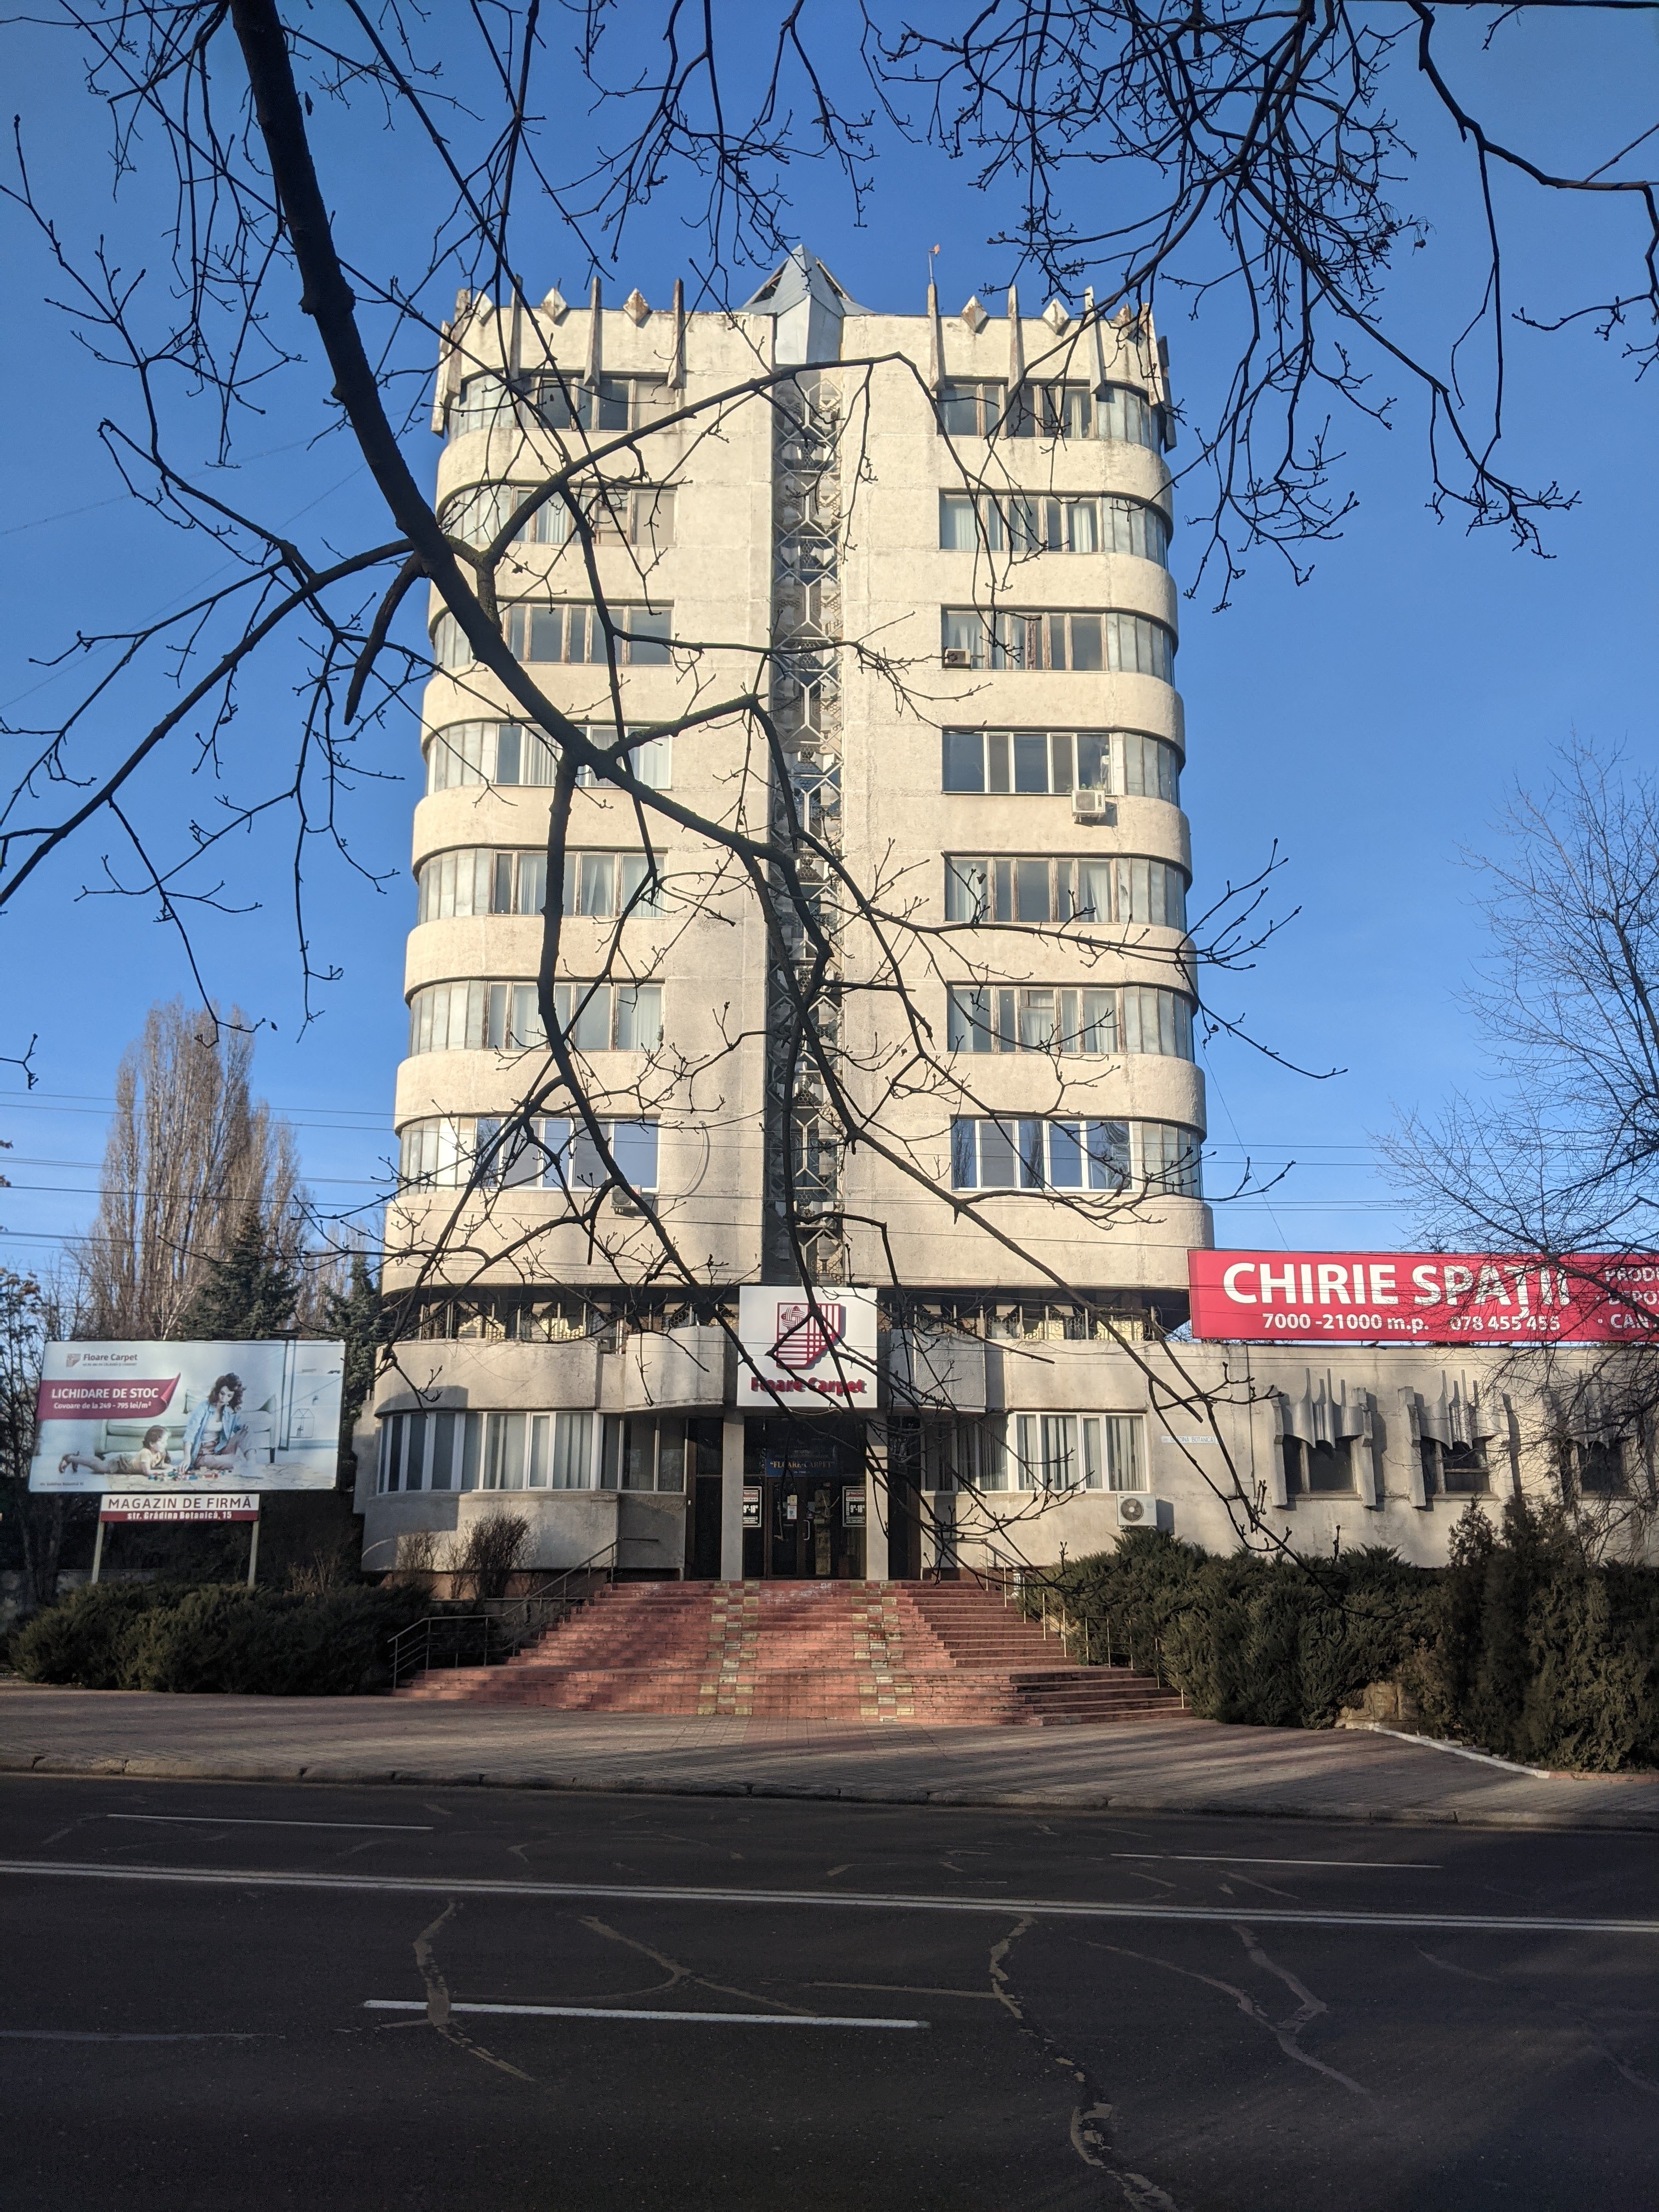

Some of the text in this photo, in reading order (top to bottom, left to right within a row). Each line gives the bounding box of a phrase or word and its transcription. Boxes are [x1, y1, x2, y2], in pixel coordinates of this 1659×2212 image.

[1605, 1267, 1659, 1282] PROD
[1223, 1262, 1398, 1304] CHIRIE
[1262, 1313, 1311, 1329] 7000
[1387, 1317, 1429, 1334] m.p.
[1449, 1316, 1483, 1331] 078
[1487, 1316, 1522, 1331] 455
[111, 1353, 138, 1362] Carpet
[52, 1387, 159, 1399] LICHIDARE DE STOC
[108, 1495, 252, 1509] MAGAZIN DE FIRMĂ
[222, 1511, 232, 1520] 15
